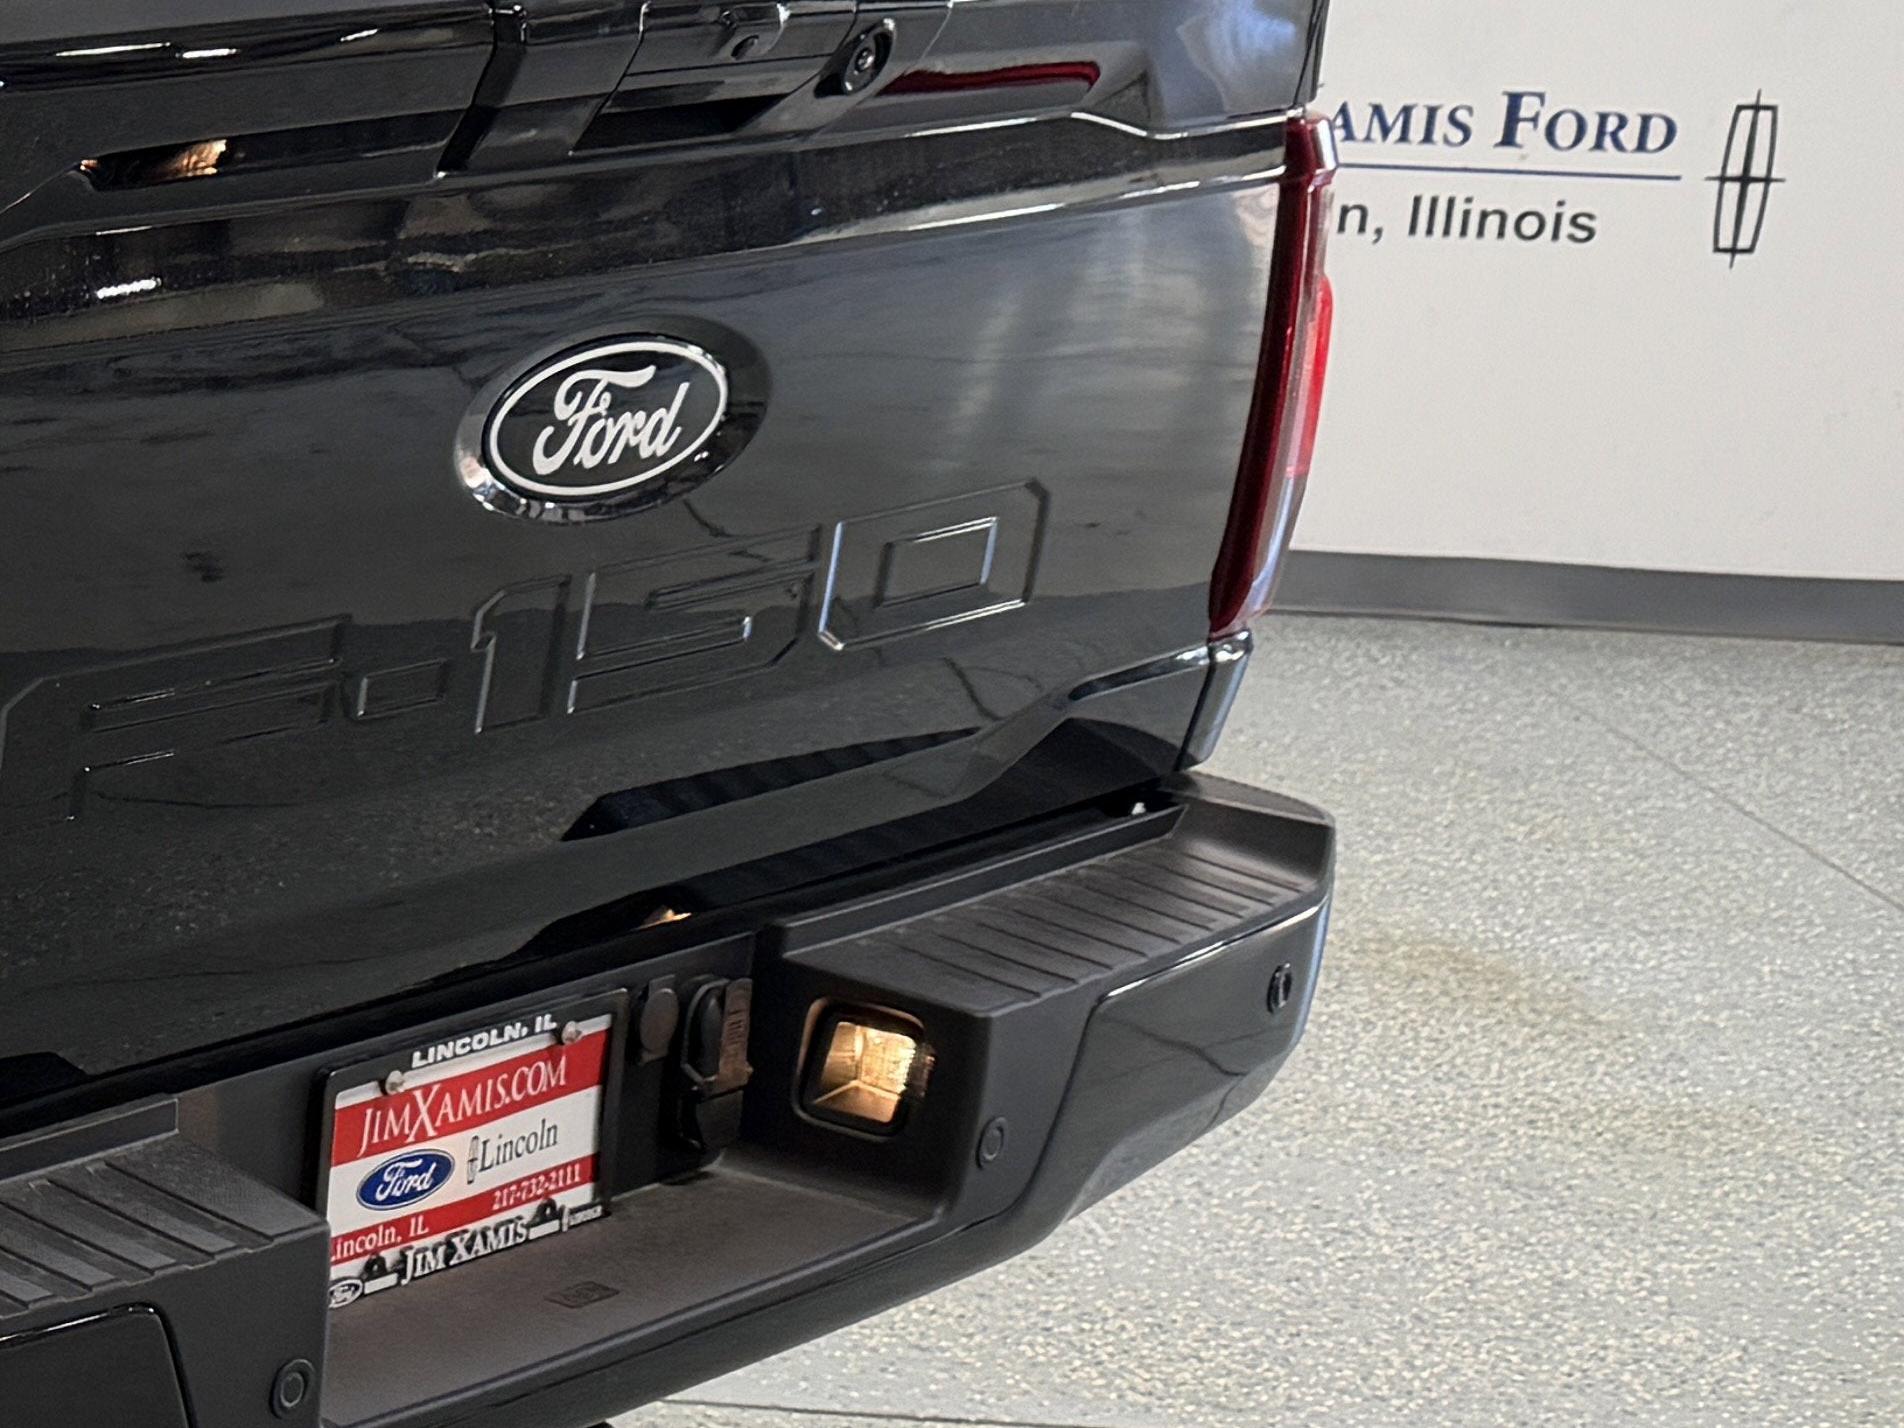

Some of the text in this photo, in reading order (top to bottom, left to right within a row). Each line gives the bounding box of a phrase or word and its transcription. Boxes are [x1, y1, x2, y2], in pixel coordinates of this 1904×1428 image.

[1333, 91, 1678, 154] AMIS FORD
[1408, 194, 1597, 245] Illinois
[531, 364, 690, 474] Ford
[411, 1013, 558, 1069] LINCOLN, IL
[479, 1119, 559, 1173] Lincoln
[374, 1157, 434, 1202] Ford
[330, 1224, 402, 1262] incoln,
[408, 1216, 430, 1238] IL
